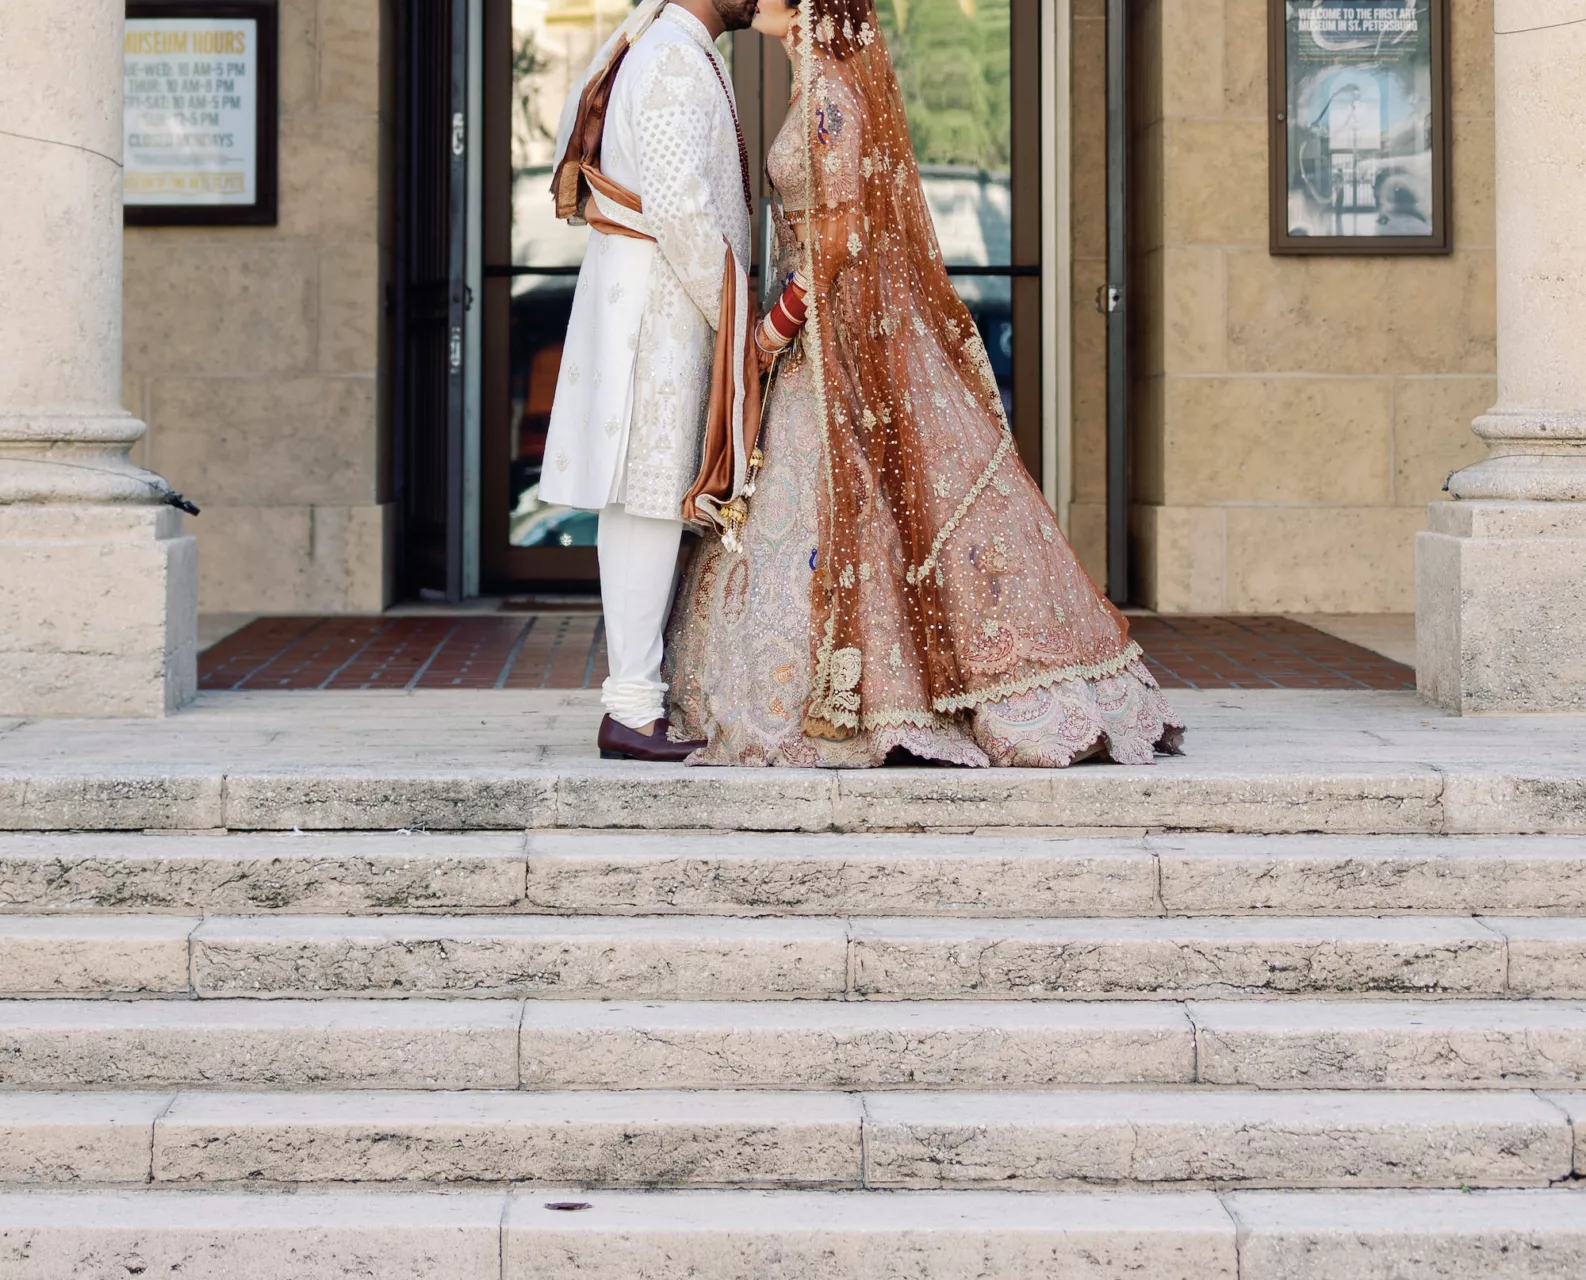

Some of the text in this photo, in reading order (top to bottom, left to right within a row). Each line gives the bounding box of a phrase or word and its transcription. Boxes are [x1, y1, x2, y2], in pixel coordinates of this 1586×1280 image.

[1298, 8, 1416, 19] WELCOME TO THE FIRST ART
[1298, 20, 1418, 31] MUSEUM IN ST. PETERSBURG
[124, 31, 246, 54] MUSEUM HOURS
[226, 62, 246, 77] PM
[166, 78, 178, 93] 10
[216, 78, 234, 93] PM
[172, 95, 185, 109] 10
[222, 95, 241, 109] PM
[200, 111, 219, 126] PM
